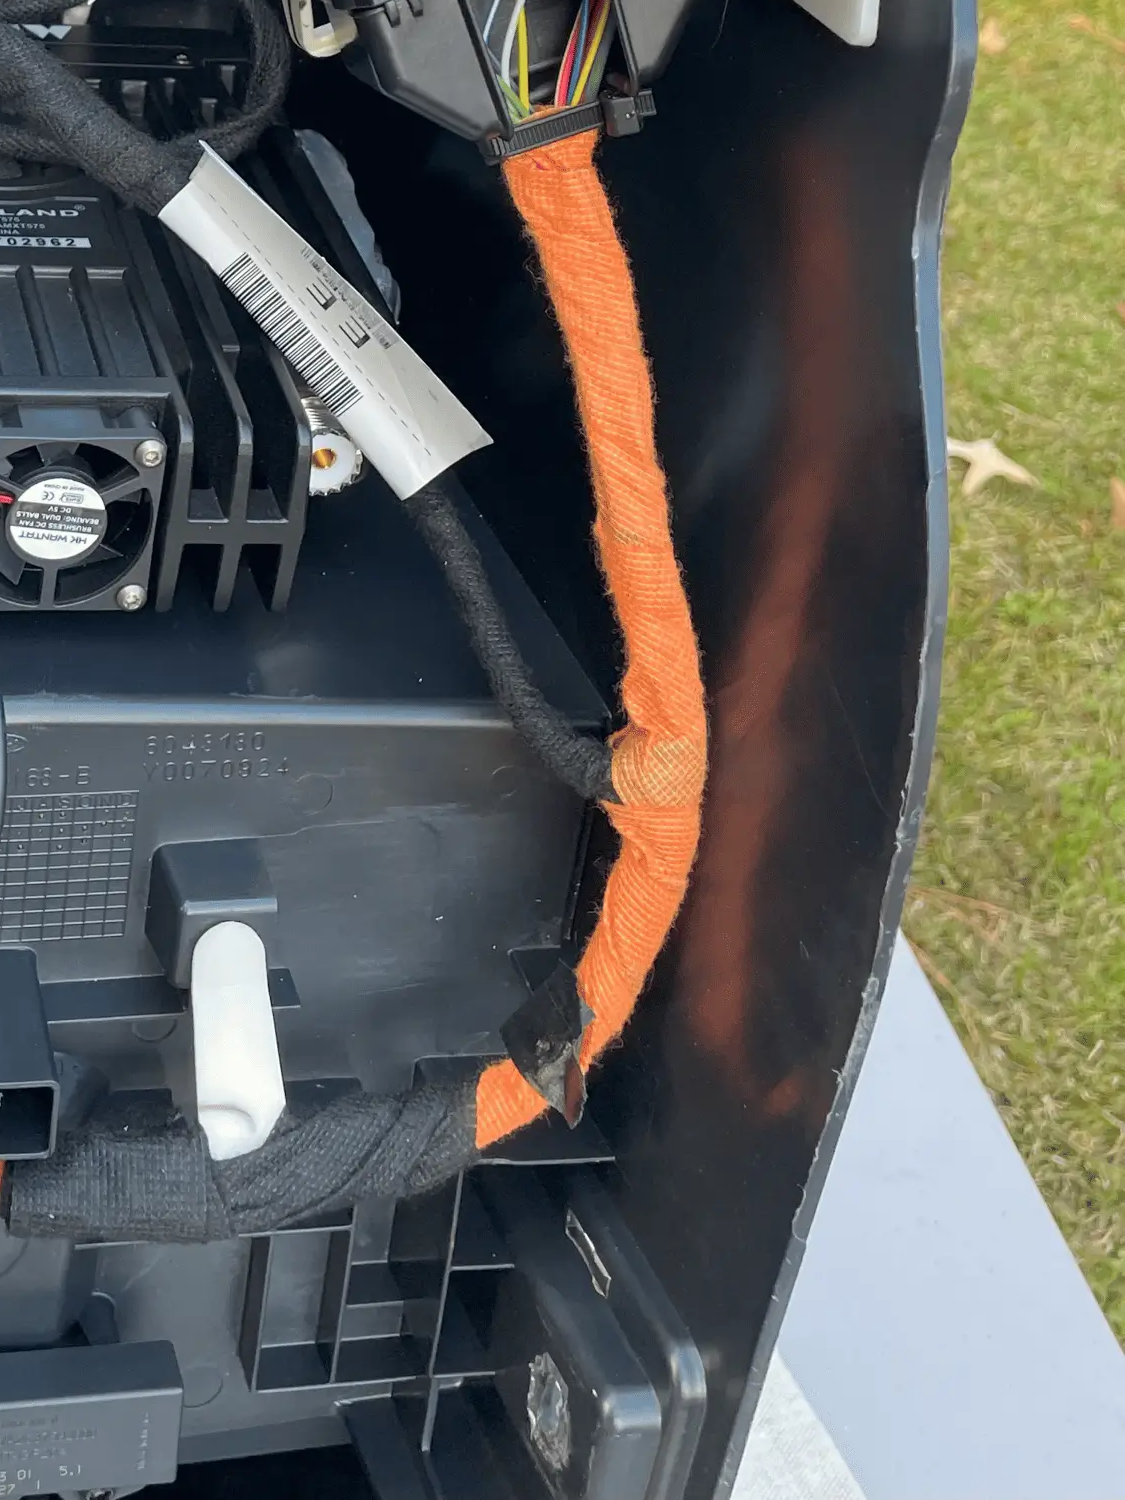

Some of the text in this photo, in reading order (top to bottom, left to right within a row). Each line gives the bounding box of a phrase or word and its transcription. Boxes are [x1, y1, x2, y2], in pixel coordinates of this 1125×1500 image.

[41, 490, 55, 501] CE
[47, 505, 59, 513] 5V
[15, 510, 100, 525] BEARING: DUAL BALLS
[48, 523, 92, 533] BRUSHLESS
